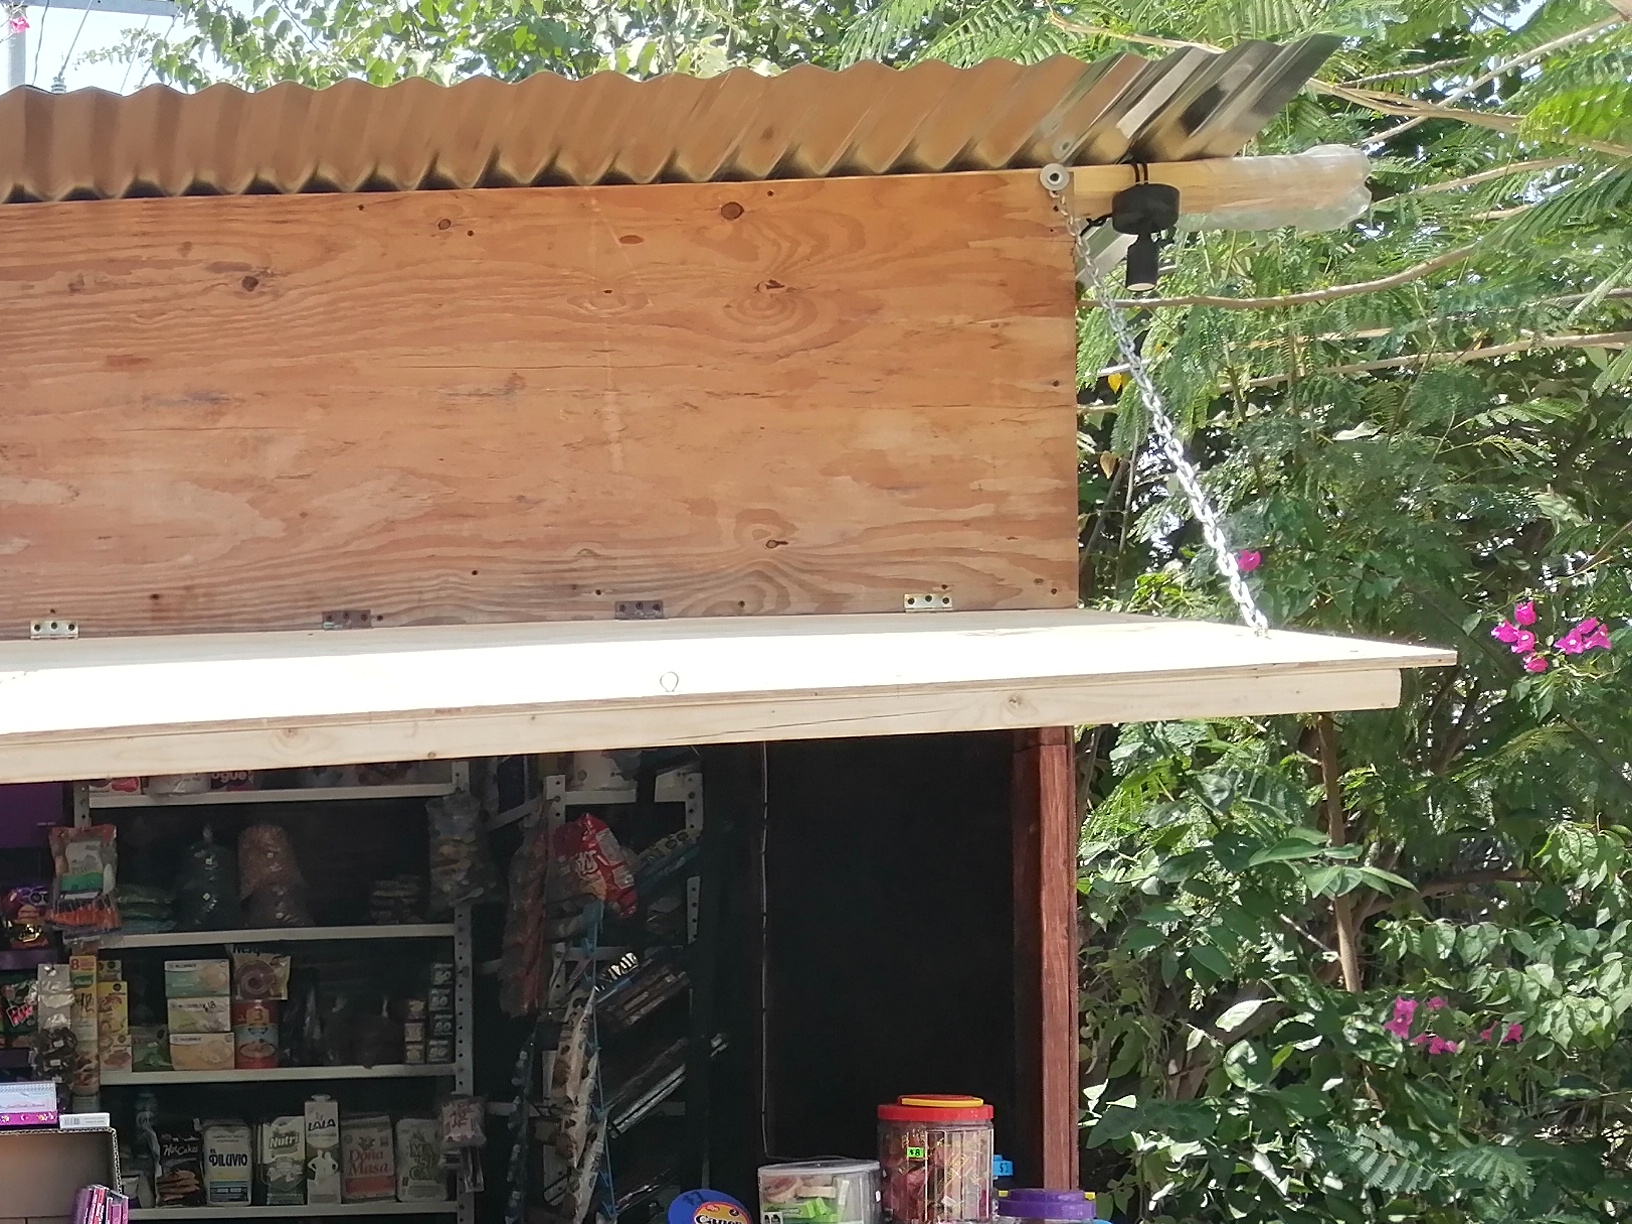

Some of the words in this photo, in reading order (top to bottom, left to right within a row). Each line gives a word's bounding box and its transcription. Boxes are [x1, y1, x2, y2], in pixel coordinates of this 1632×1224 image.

[70, 958, 79, 970] 8
[308, 1119, 335, 1131] LALA
[270, 1133, 299, 1148] Nutri
[209, 1154, 248, 1166] DILUVIO
